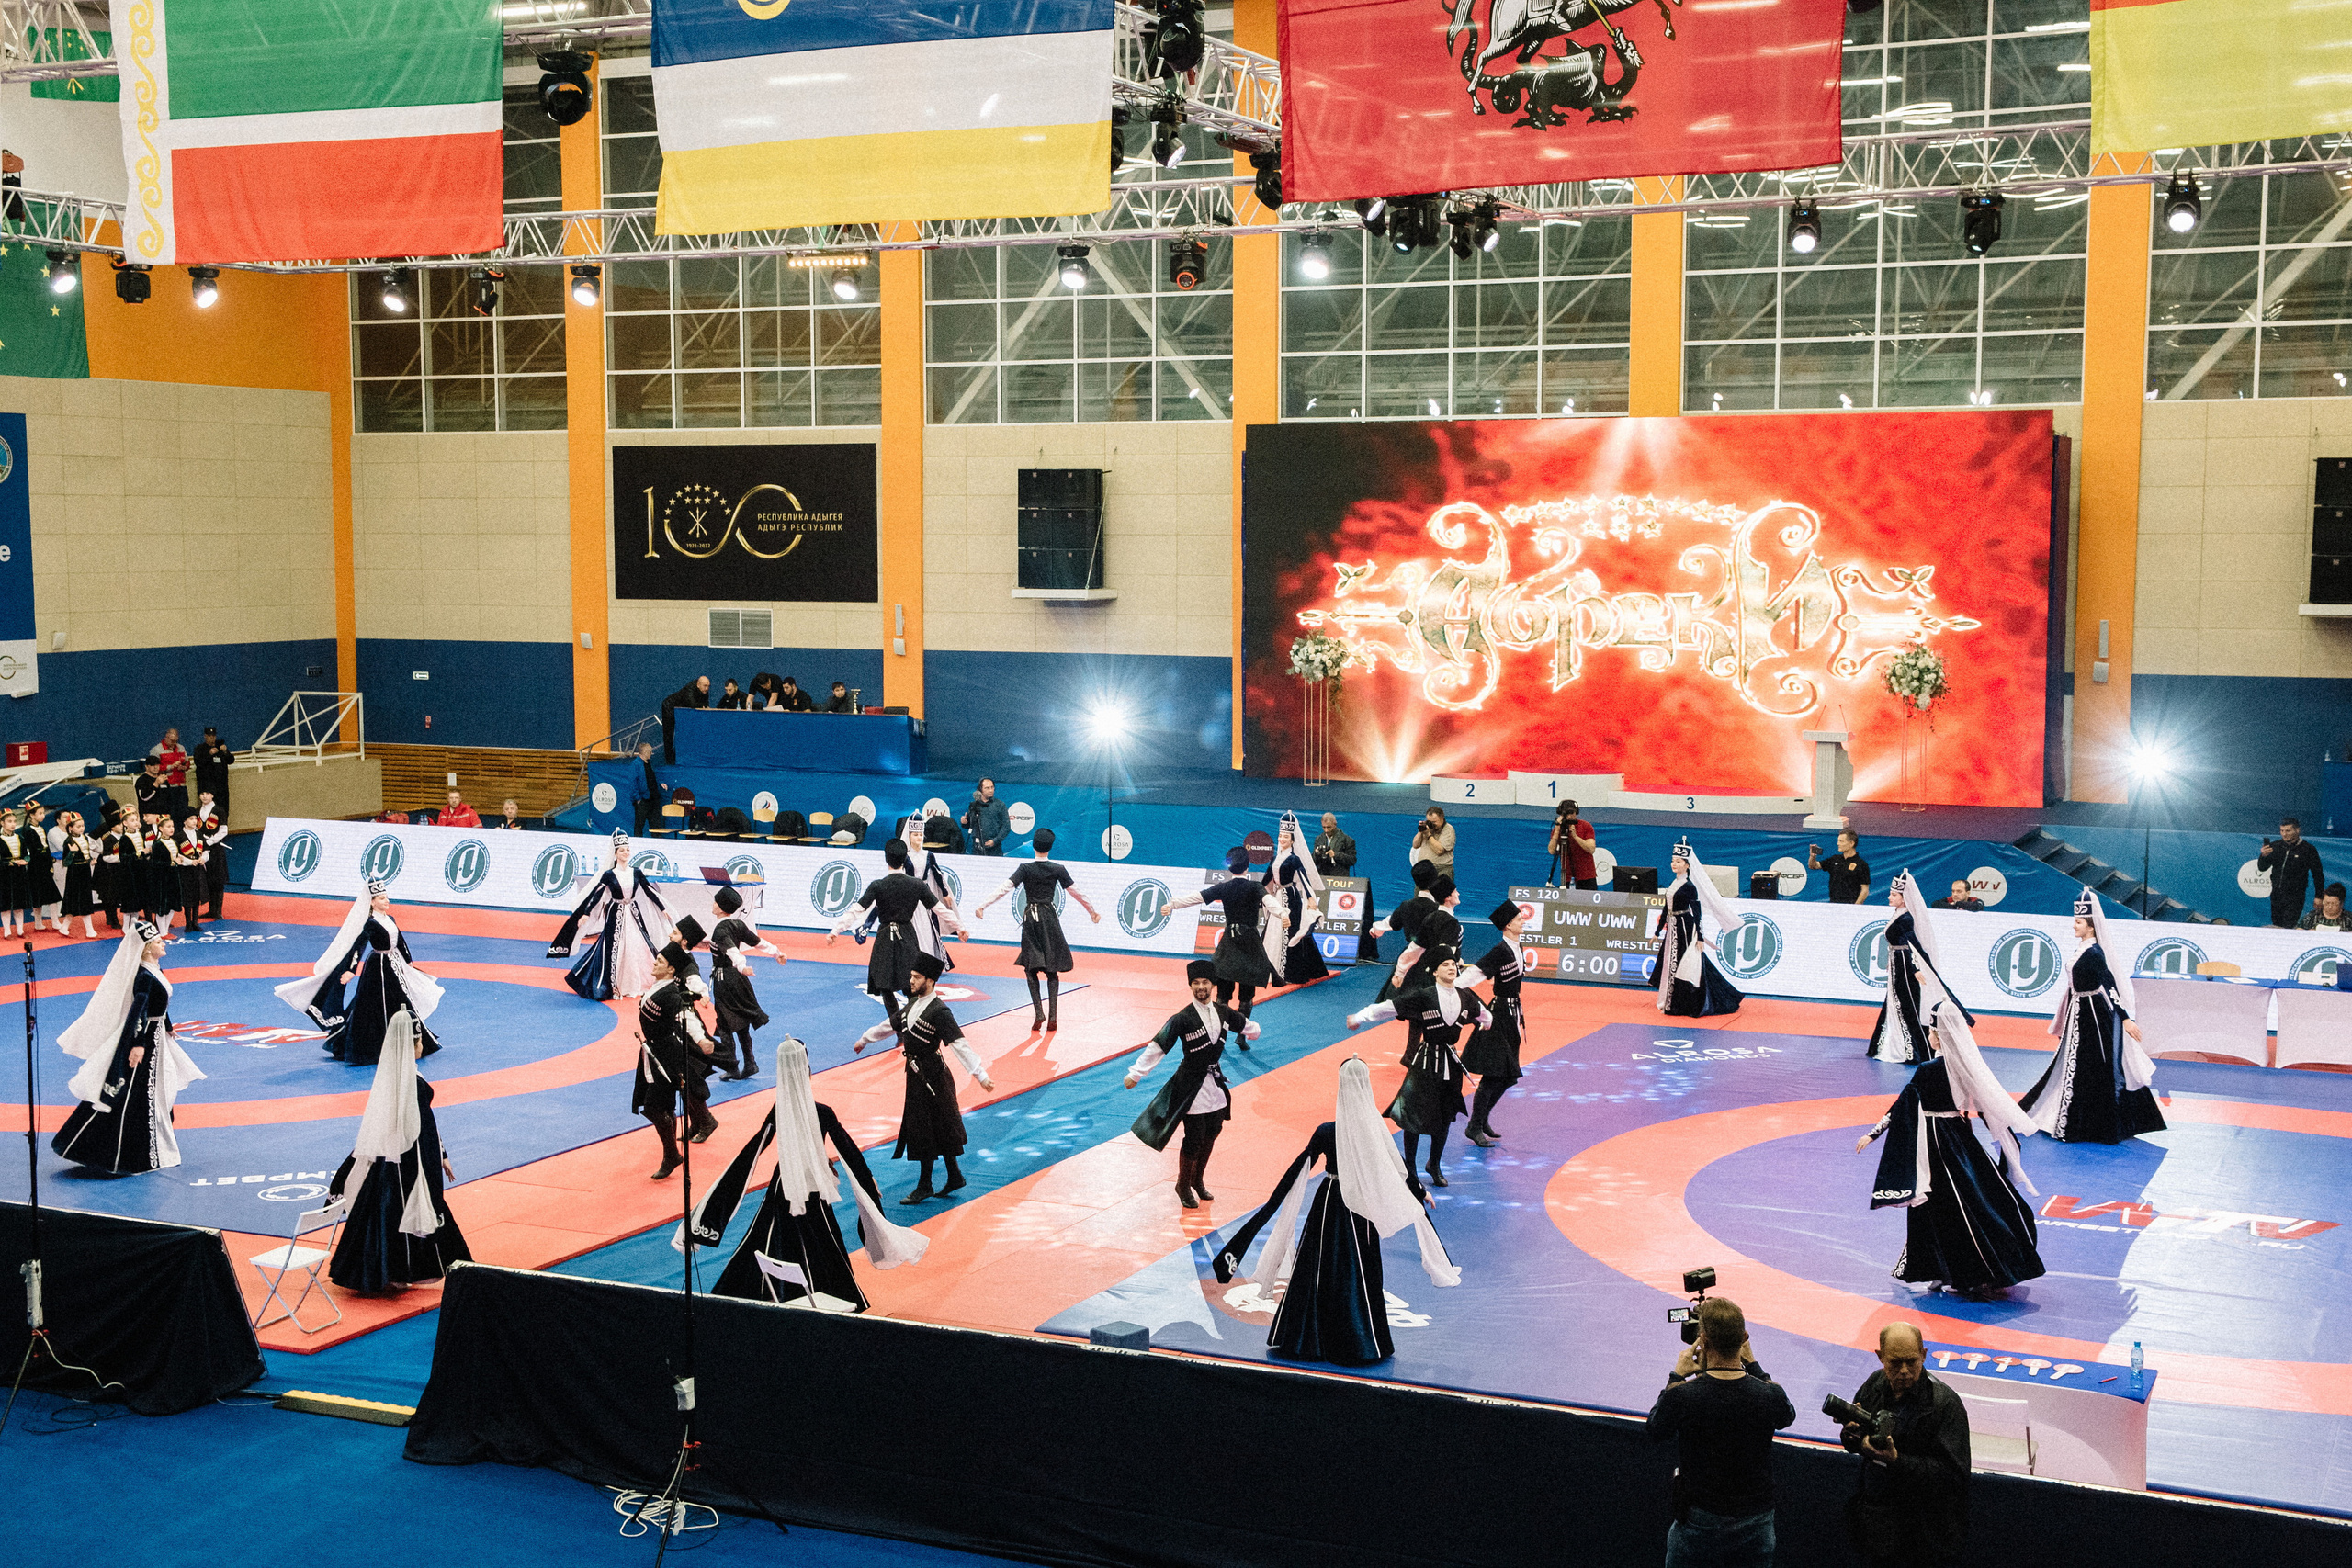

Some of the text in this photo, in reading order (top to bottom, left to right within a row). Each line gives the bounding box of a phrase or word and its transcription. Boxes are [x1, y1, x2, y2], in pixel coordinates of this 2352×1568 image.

[811, 513, 843, 522] АДЫГЕЯ
[757, 524, 842, 532] АДЫГЭ РЕСПУБЛИК
[1465, 784, 1475, 797] 2
[1547, 781, 1556, 798] 1
[1687, 797, 1695, 809] 3
[1212, 872, 1226, 881] FS
[1326, 878, 1355, 888] Tour
[1515, 889, 1560, 900] FS 120
[1592, 893, 1601, 903] 0
[1643, 897, 1666, 906] Tou
[1199, 914, 1265, 926] WRES 1
[1554, 910, 1637, 929] UWW UWW
[1314, 920, 1360, 932] STLER 2
[1322, 935, 1340, 957] 0
[1519, 934, 1577, 946] ESTLER 1
[1606, 939, 1663, 951] WRESTLE
[1562, 954, 1618, 976] 6:00
[1631, 1046, 1783, 1060] ALROSA
[1660, 1054, 1771, 1064] DIAMONDS
[190, 1170, 338, 1186] MPBET
